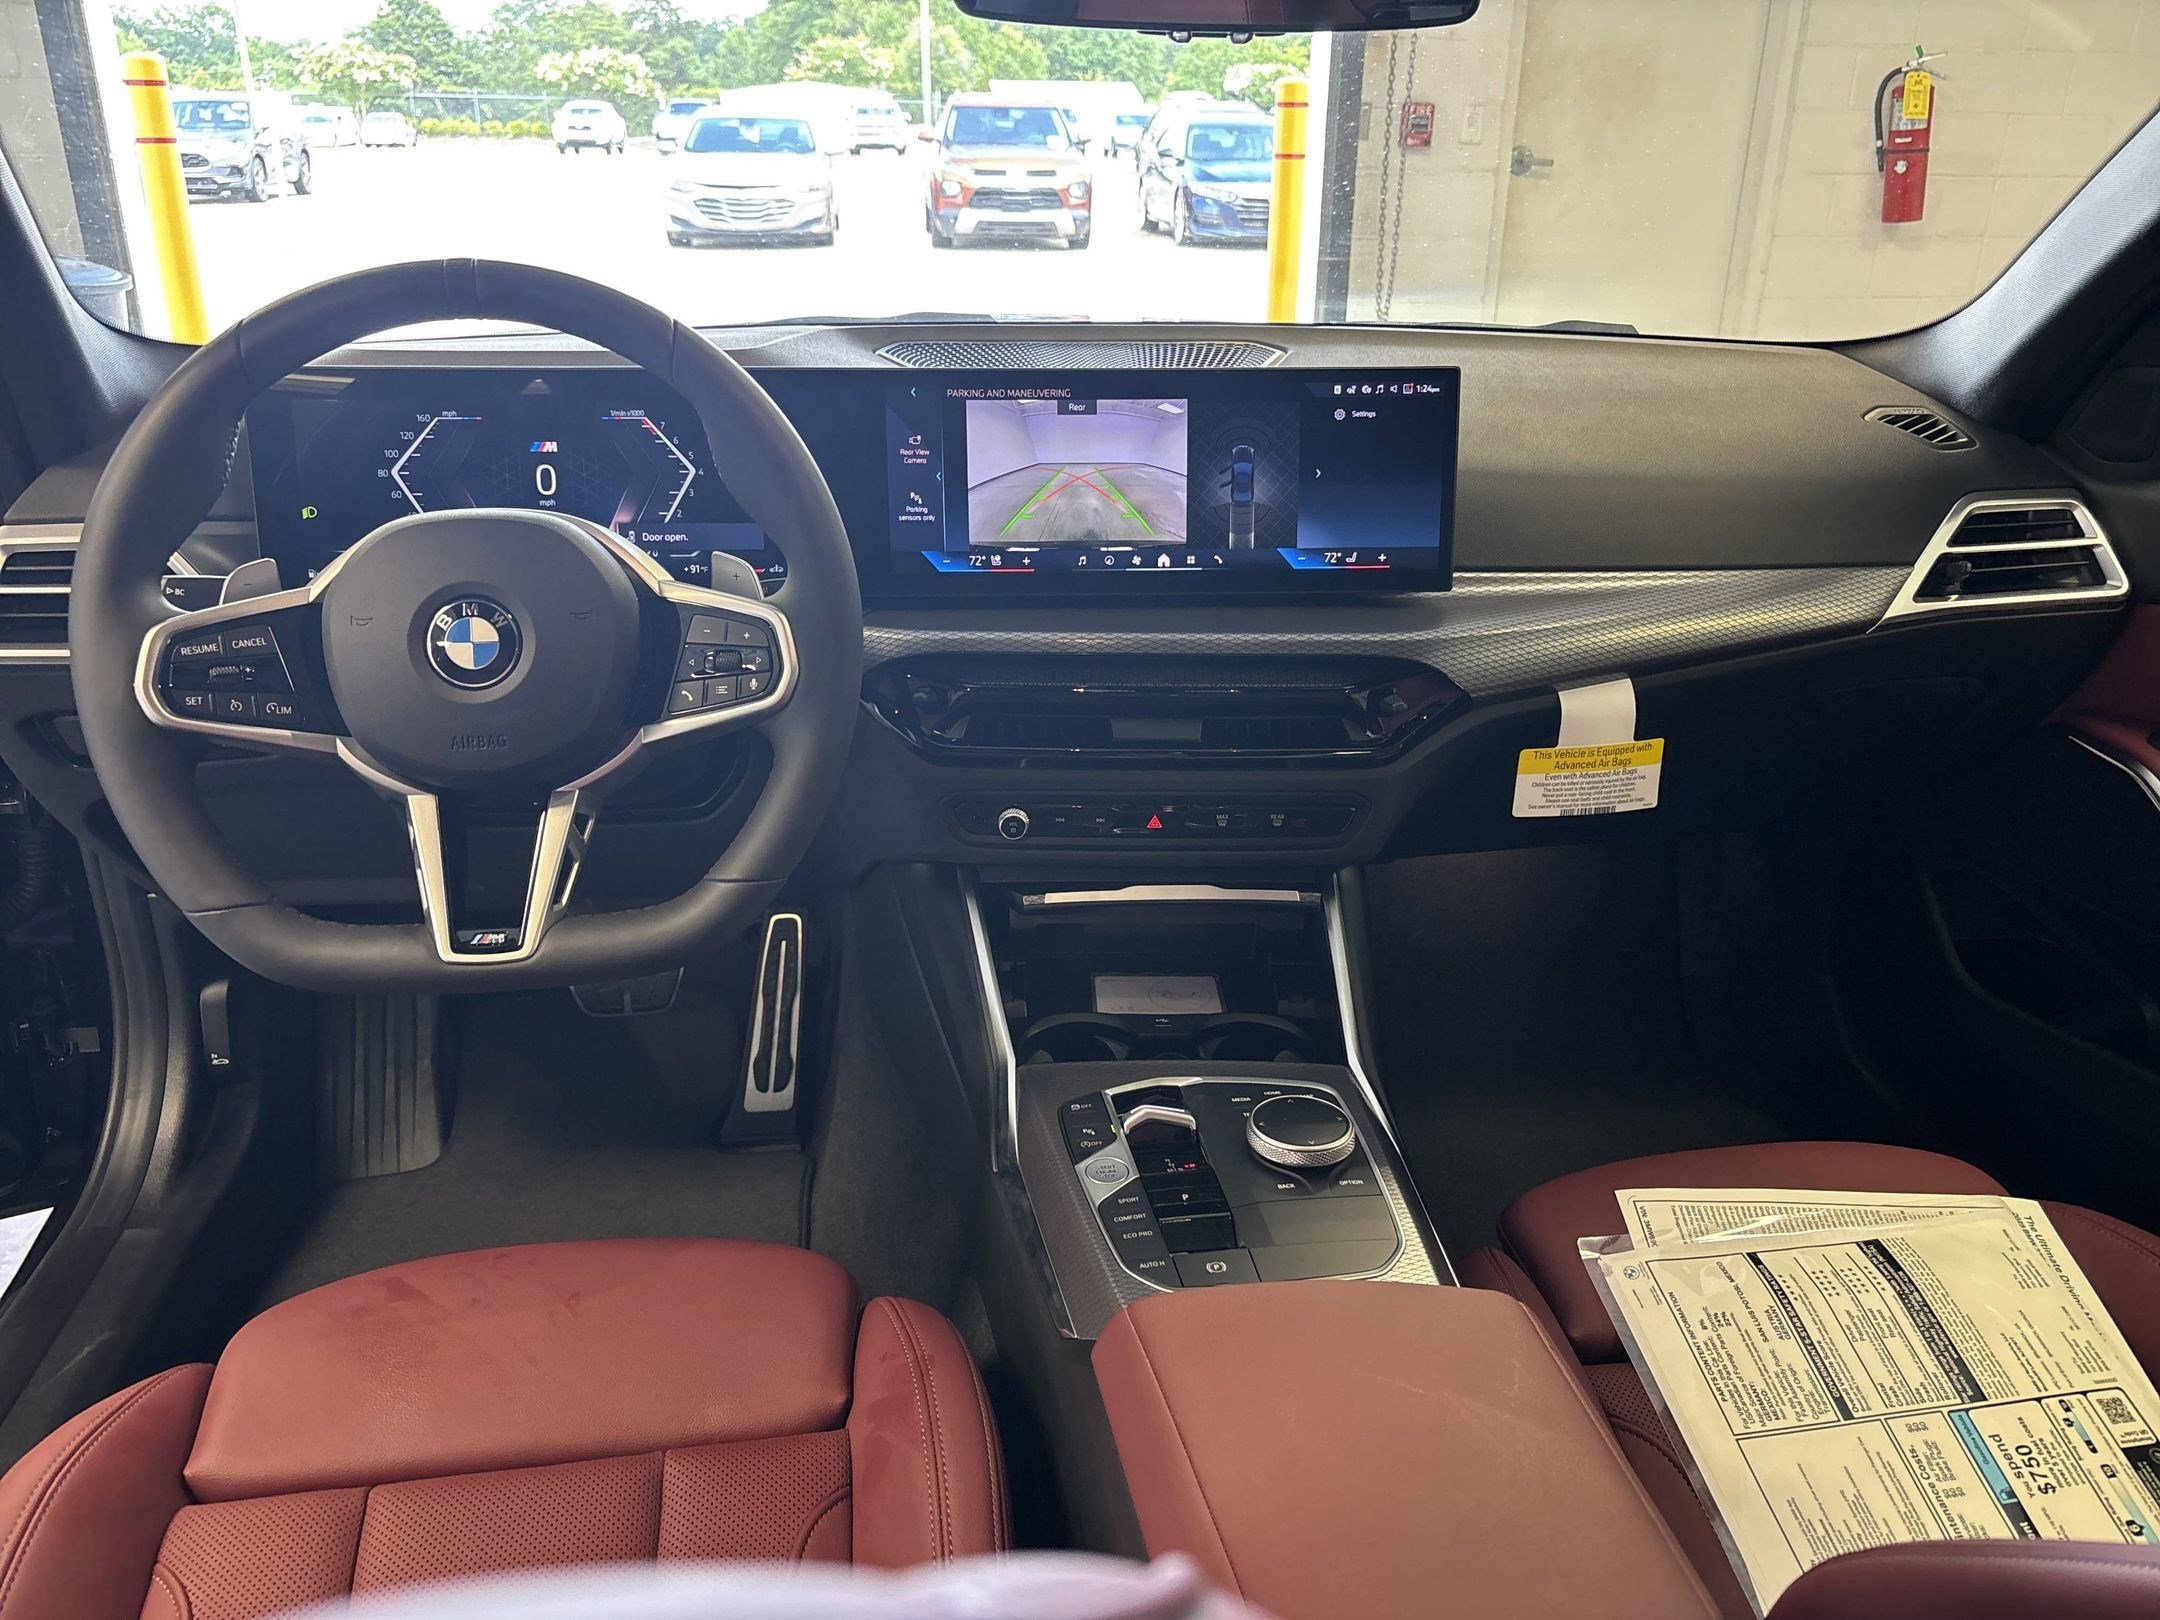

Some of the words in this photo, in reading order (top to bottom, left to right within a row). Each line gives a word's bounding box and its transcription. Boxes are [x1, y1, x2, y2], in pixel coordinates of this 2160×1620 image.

[946, 388, 985, 398] PARKING
[986, 388, 1006, 398] AND
[1007, 388, 1071, 398] MANEUVERING
[1416, 384, 1440, 394] 1:24pm
[1068, 403, 1086, 411] Rear
[1351, 410, 1377, 419] Settings
[416, 414, 431, 423] 160
[399, 431, 415, 440] 120
[673, 436, 679, 444] 6
[384, 449, 399, 458] 100
[688, 451, 694, 460] 5
[899, 448, 915, 456] Rear
[915, 448, 930, 456] View
[377, 469, 389, 478] 80
[535, 463, 557, 496] 0
[698, 468, 704, 476] 4
[391, 490, 403, 499] 60
[688, 488, 694, 497] 3
[539, 499, 556, 507] mph
[905, 506, 929, 515] Parking
[676, 509, 683, 518] 2
[642, 532, 663, 542] Door
[664, 534, 689, 543] open.
[968, 555, 987, 566] 72°
[1324, 552, 1342, 563] 72°
[174, 588, 185, 596] BC
[436, 602, 509, 632] BMW
[180, 643, 220, 656] RESUME
[232, 637, 267, 649] CANCEL
[185, 696, 203, 705] SET
[276, 706, 292, 715] LIM
[450, 735, 509, 751] AIRBAG
[1534, 750, 1552, 760] This
[1554, 749, 1586, 759] Vehicle
[1587, 749, 1595, 758] is
[1596, 744, 1635, 758] Equipped
[1636, 742, 1653, 752] with
[1553, 760, 1596, 771] Advanced
[1598, 758, 1609, 768] Air
[1612, 756, 1632, 767] Bags
[1544, 773, 1562, 781] Even
[1563, 771, 1578, 780] with
[1579, 769, 1611, 780] Advanced
[1612, 768, 1621, 777] Air
[1622, 767, 1638, 777] Bags
[1117, 1196, 1139, 1204] SPORT
[1113, 1212, 1147, 1223] COMFORT
[1639, 1206, 1647, 1218] VIN:
[1122, 1231, 1138, 1240] ECO
[1138, 1230, 1153, 1238] PRO
[2024, 1217, 2037, 1232] The
[2035, 1234, 2060, 1272] Ultimate
[1139, 1261, 1159, 1270] AUTO
[1716, 1262, 1735, 1283] MEXICO
[1758, 1265, 1779, 1289] RATINGS
[1777, 1291, 1796, 1316] SAFETY
[1669, 1292, 1696, 1339] INFORMATION
[1702, 1306, 1718, 1332] Content:
[1713, 1312, 1724, 1328] 24%
[1721, 1311, 1732, 1326] 22%
[1748, 1310, 1761, 1326] LUIS
[1768, 1305, 1791, 1339] GERMANY
[1867, 1308, 1878, 1321] seat
[1876, 1309, 1887, 1322] seat
[1699, 1319, 1708, 1330] 8%
[1764, 1309, 1784, 1340] AUSTRIA
[1792, 1317, 1811, 1344] 5-STAR
[1845, 1310, 1866, 1341] Passenger
[1875, 1322, 1888, 1338] Front
[1885, 1324, 1896, 1338] Rear
[1716, 1333, 1727, 1349] Parts
[1757, 1327, 1769, 1342] SAN
[1845, 1324, 1858, 1342] Driver
[1703, 1340, 1714, 1355] Line:
[1708, 1336, 1724, 1362] Content:
[1817, 1340, 1830, 1360] Score
[1693, 1342, 1714, 1375] CONTENT
[1711, 1357, 1720, 1368] Car
[1725, 1351, 1740, 1375] Foreign
[1769, 1349, 1782, 1367] Point:
[1717, 1369, 1726, 1380] this
[1722, 1364, 1733, 1380] Parts
[1787, 1363, 1801, 1384] Origin:
[1807, 1346, 1839, 1397] GOVERNMENT
[1828, 1361, 1844, 1387] Vehicle
[1711, 1377, 1728, 1402] PARTS
[1780, 1368, 1799, 1399] Assembly
[1804, 1369, 1830, 1413] Transmission:
[1928, 1372, 1951, 1400] Rollover
[1742, 1384, 1757, 1407] Source
[1877, 1383, 1896, 1408] Frontal
[1889, 1386, 1904, 1407] Crash
[1915, 1388, 1926, 1403] Side
[1920, 1382, 1934, 1402] Crash
[1727, 1389, 1744, 1416] Vehicles
[1731, 1382, 1755, 1424] US/Canadian
[1749, 1382, 1772, 1421] GERMANY:
[1761, 1389, 1780, 1420] MEXICO:
[1803, 1394, 1820, 1419] Country
[1808, 1390, 1826, 1415] Engine:
[1842, 1388, 1859, 1413] Overall
[1795, 1401, 1809, 1417] Final
[1741, 1417, 1751, 1429] For
[1754, 1408, 1767, 1427] Major
[2018, 1417, 2034, 1438] costs
[1923, 1440, 1939, 1460] Plugs:
[2030, 1440, 2044, 1455] fuel
[2039, 1438, 2056, 1459] years
[1909, 1445, 1930, 1480] Costs.
[1922, 1452, 1936, 1471] Filter:
[1989, 1434, 2024, 1479] spend
[1934, 1473, 1942, 1482] Air
[1935, 1462, 1951, 1482] Spark
[1942, 1460, 1956, 1480] Brake
[2015, 1445, 2056, 1494] $750
[2048, 1467, 2064, 1488] more
[2057, 1469, 2072, 1487] over
[2023, 1481, 2035, 1498] You
